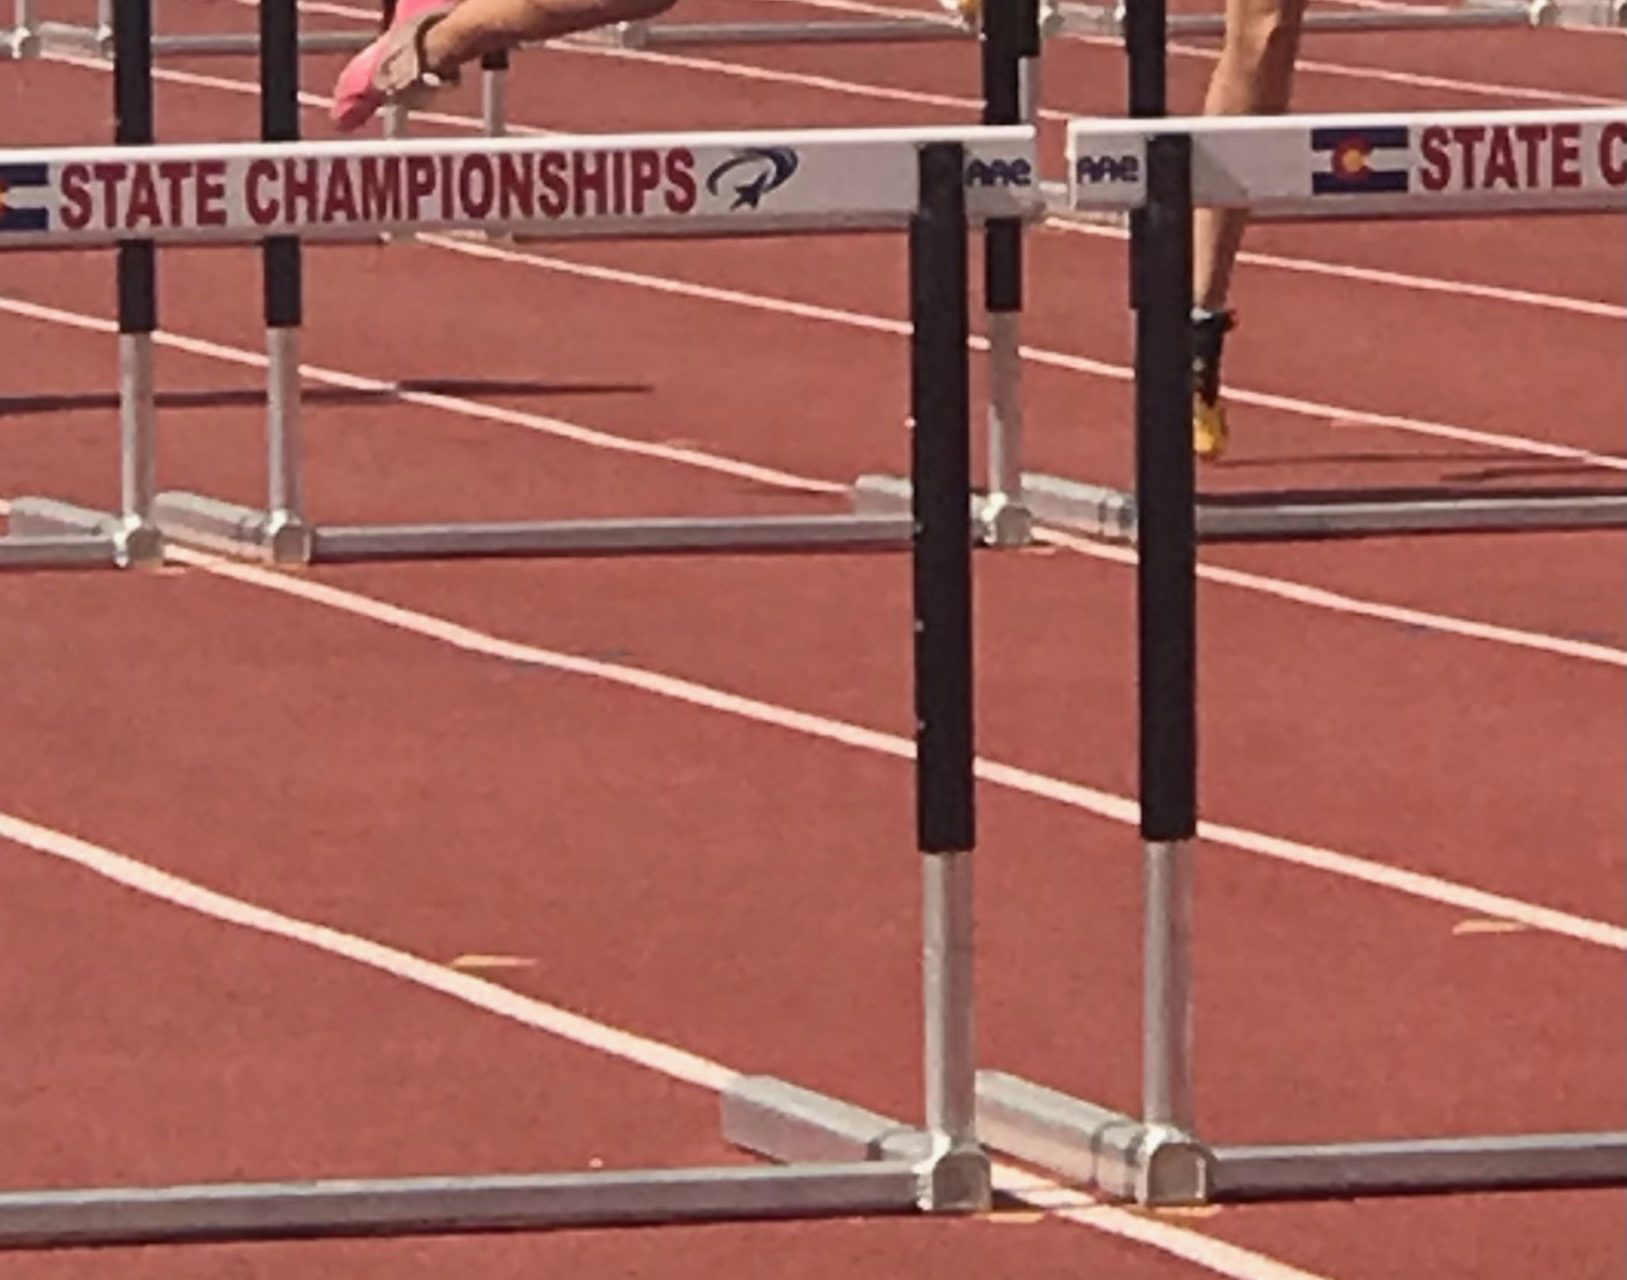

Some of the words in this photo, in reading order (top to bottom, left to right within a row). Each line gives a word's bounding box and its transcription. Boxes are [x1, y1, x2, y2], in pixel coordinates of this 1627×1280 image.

[60, 160, 227, 230] STATE
[245, 147, 696, 223] CHAMPIONSHIPS
[1420, 124, 1582, 190] STATE
